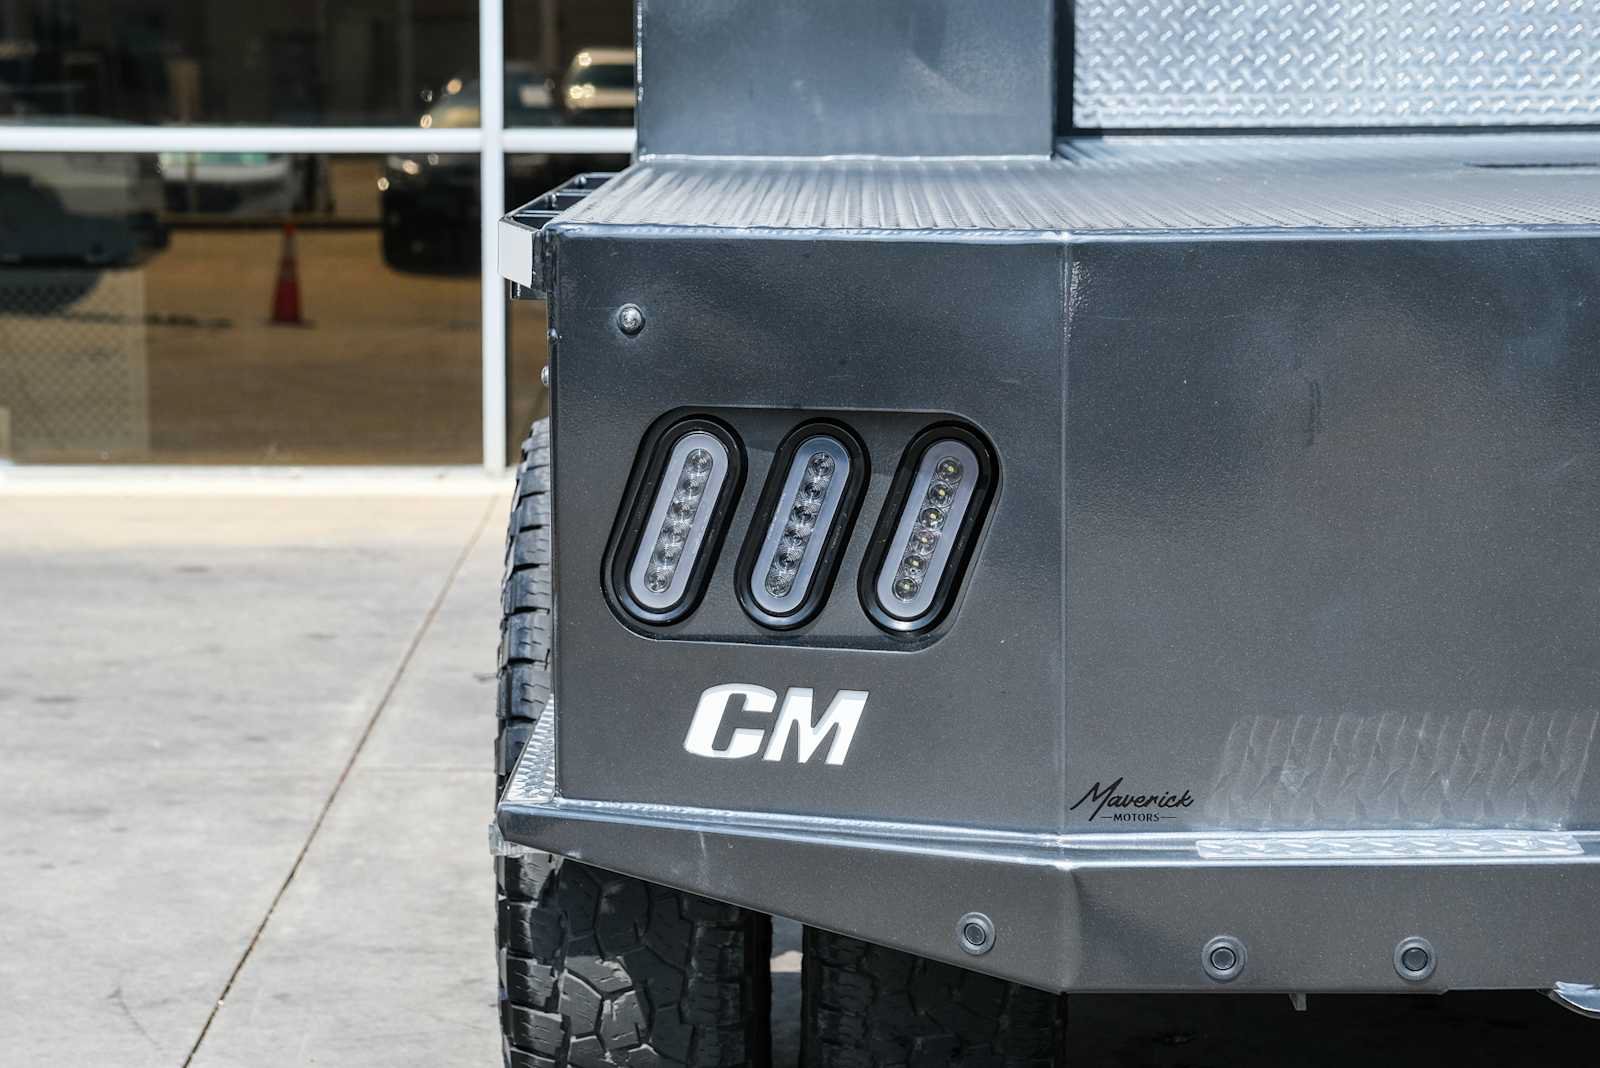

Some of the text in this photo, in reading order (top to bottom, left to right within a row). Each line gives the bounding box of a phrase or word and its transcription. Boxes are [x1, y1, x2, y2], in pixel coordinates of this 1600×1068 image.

[684, 683, 869, 766] CM
[1070, 777, 1194, 821] Maverick
[1113, 813, 1160, 822] MOTORS
